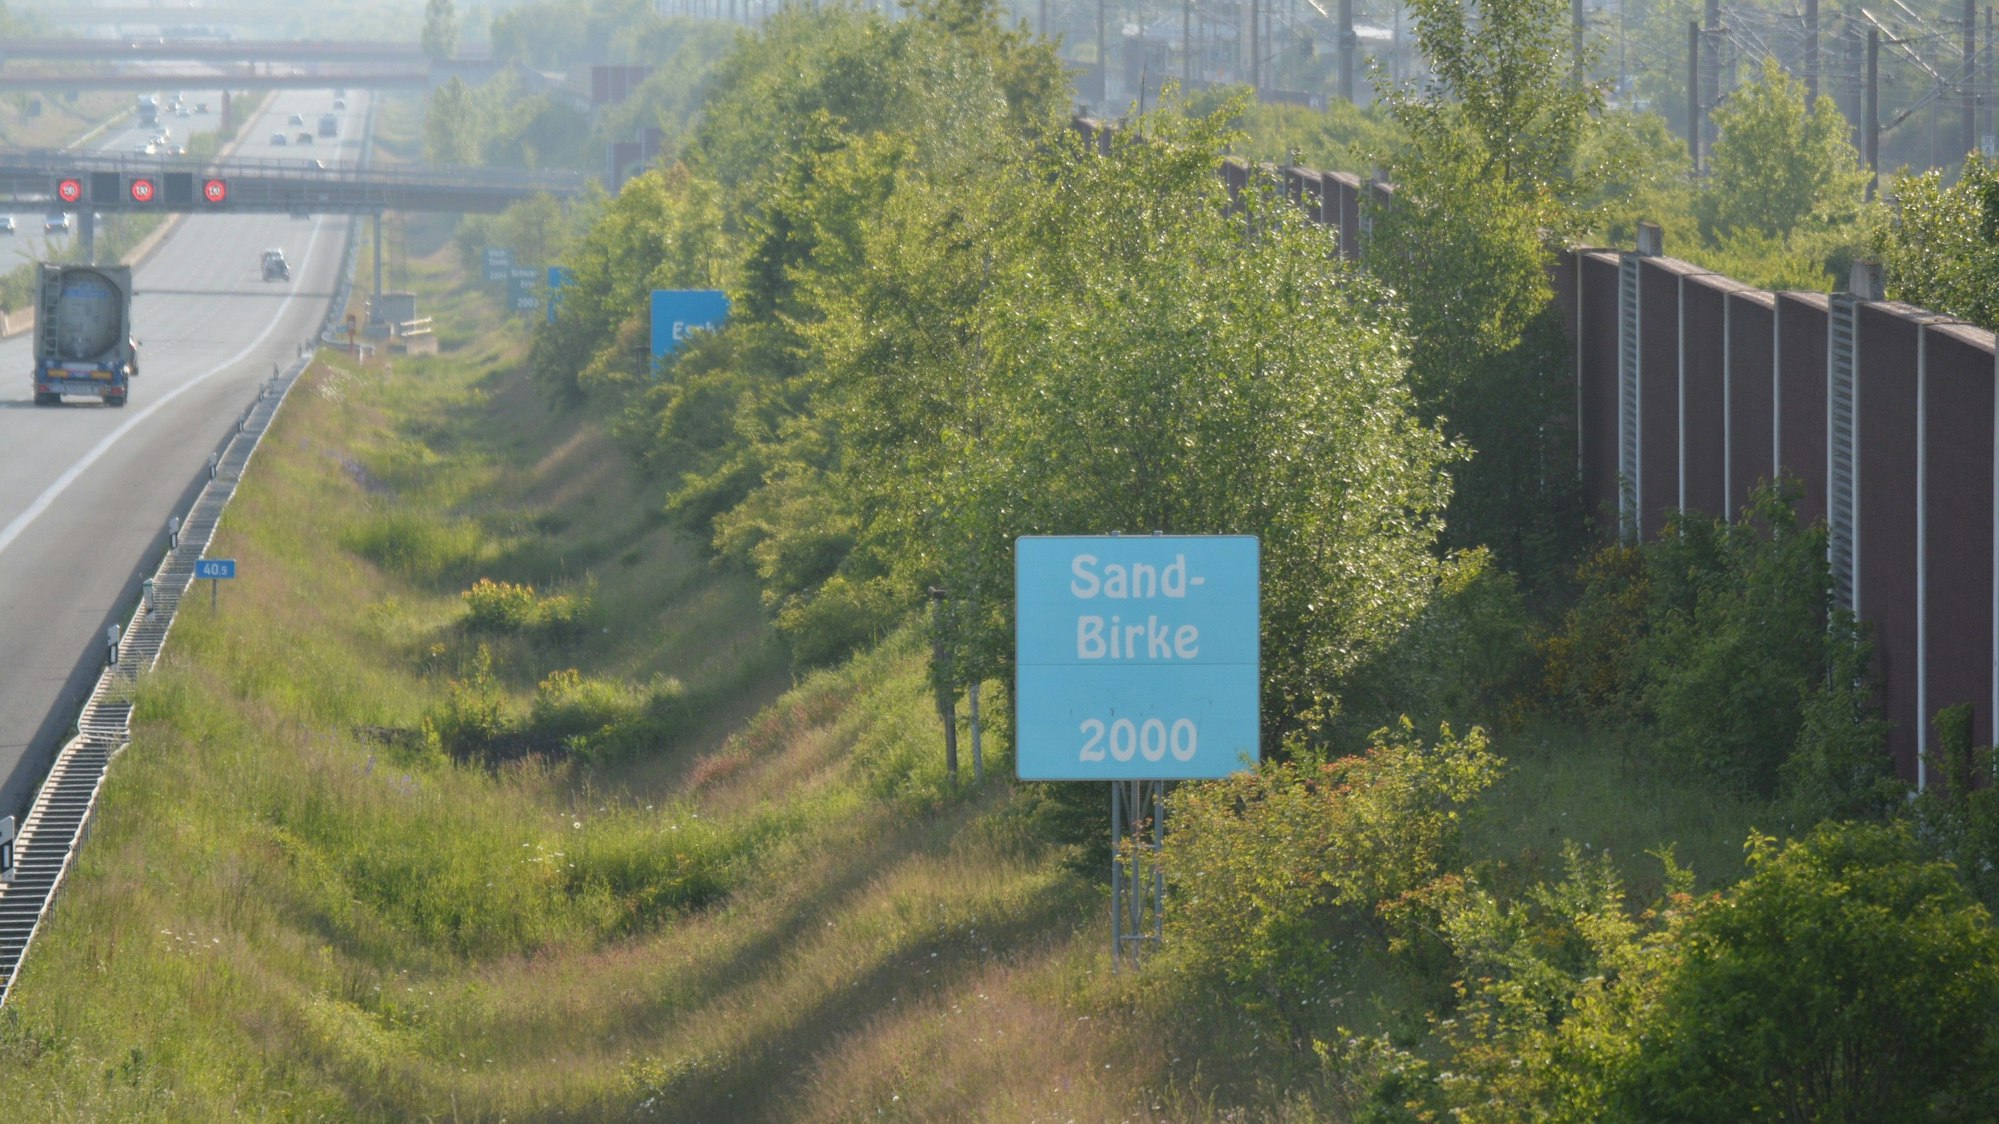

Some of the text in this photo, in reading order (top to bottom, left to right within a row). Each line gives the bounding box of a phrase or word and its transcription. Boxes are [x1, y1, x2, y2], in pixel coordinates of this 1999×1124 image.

[1070, 554, 1205, 599] Sand-
[1077, 615, 1199, 659] Birke
[1079, 718, 1197, 762] 2000
